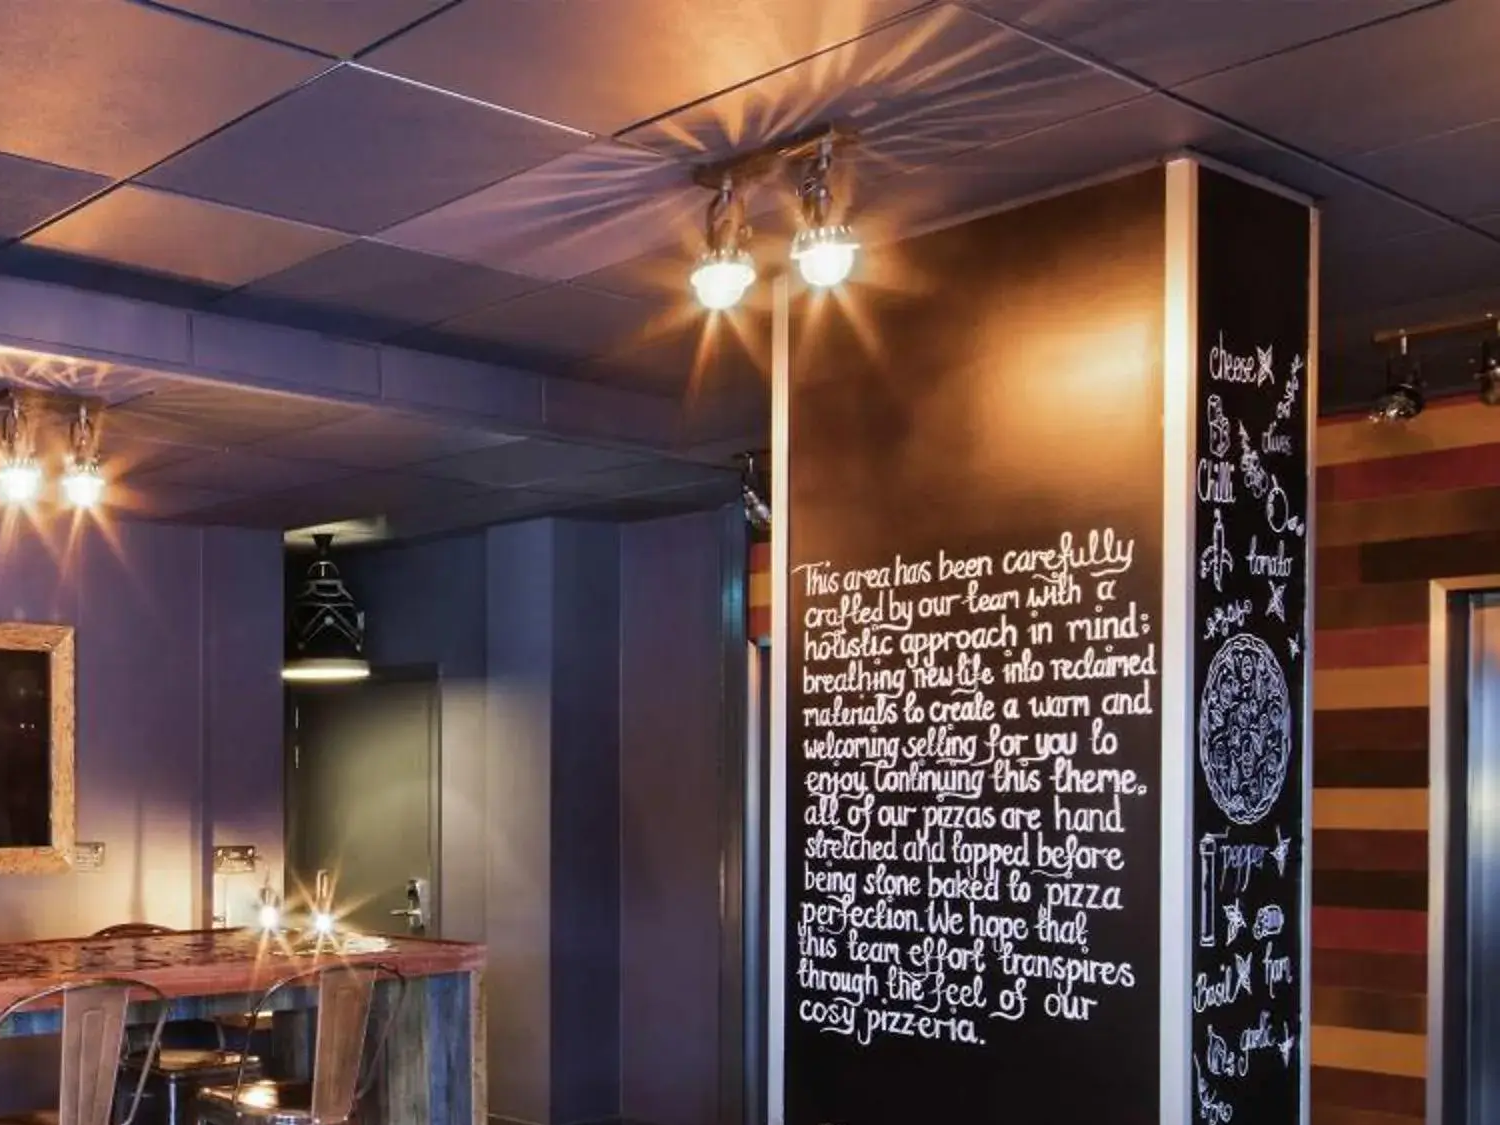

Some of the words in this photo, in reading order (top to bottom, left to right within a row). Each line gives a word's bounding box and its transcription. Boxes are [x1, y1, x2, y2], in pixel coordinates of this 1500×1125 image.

[791, 560, 840, 597] This
[842, 567, 891, 592] area
[894, 554, 932, 587] has
[938, 549, 993, 581] been
[1002, 527, 1135, 583] carefully
[804, 590, 884, 636] crafted
[874, 588, 913, 631] by
[918, 594, 962, 618] our
[963, 579, 1020, 614] team
[1025, 573, 1082, 608] with
[1097, 579, 1117, 601] a
[804, 627, 894, 661] holistic
[900, 614, 1019, 669] approach
[1028, 610, 1053, 645] in
[1066, 601, 1151, 643] mind:
[803, 657, 907, 699] breathing
[912, 666, 953, 688] new
[952, 652, 995, 696] life
[1002, 647, 1045, 684] into
[1050, 643, 1157, 681] reclaimed
[803, 693, 899, 727] materials
[903, 690, 925, 723] to
[929, 691, 996, 722] create
[1002, 697, 1020, 719] a
[1027, 695, 1091, 718] warm
[1101, 678, 1153, 715] and
[804, 726, 900, 769] welcoming
[972, 723, 1028, 766] for
[1017, 731, 1078, 761] you
[1089, 717, 1118, 755] to
[988, 758, 1042, 794] this
[804, 796, 840, 825] all
[834, 793, 875, 837] of
[877, 804, 917, 827] our
[920, 802, 997, 841] pizzas
[1001, 806, 1042, 830] are
[1053, 794, 1126, 833] hand
[804, 828, 898, 860] stretched
[903, 827, 946, 863] and
[952, 829, 1030, 881] topped
[1031, 831, 1125, 879] before
[804, 859, 857, 902] being
[863, 863, 921, 896] stone
[928, 864, 1000, 901] baked
[1006, 868, 1031, 903] to
[1044, 882, 1124, 915] pizza
[799, 894, 925, 935] perfection.
[925, 899, 965, 935] We
[969, 901, 1029, 952] hope
[1034, 902, 1088, 945] that
[798, 924, 837, 958] this
[847, 929, 901, 964] team
[904, 936, 987, 982] effort
[998, 941, 1135, 994] transpires
[796, 957, 879, 1007] through
[886, 964, 925, 1001] the
[915, 971, 987, 1013] feel
[989, 977, 1028, 1021] of
[1044, 993, 1099, 1021] our
[799, 999, 855, 1035] cosy
[858, 1001, 987, 1045] pizzeria.
